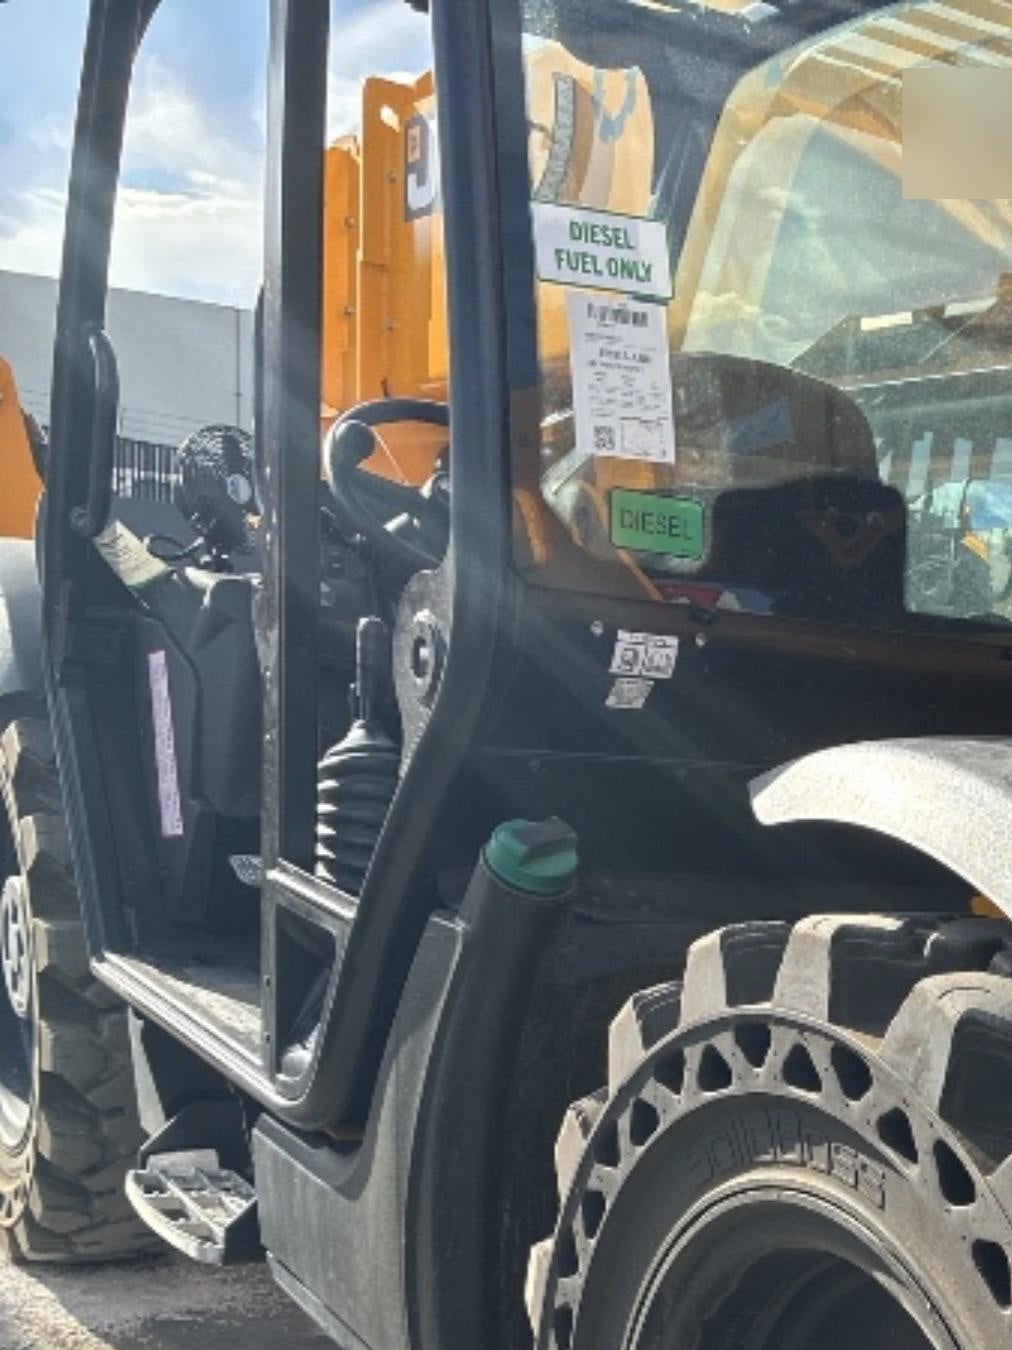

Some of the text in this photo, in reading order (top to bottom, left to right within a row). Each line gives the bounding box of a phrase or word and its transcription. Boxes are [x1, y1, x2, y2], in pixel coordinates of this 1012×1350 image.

[568, 220, 636, 249] DIESEL
[554, 248, 652, 282] FUEL ONLY
[620, 508, 694, 540] DIESEL
